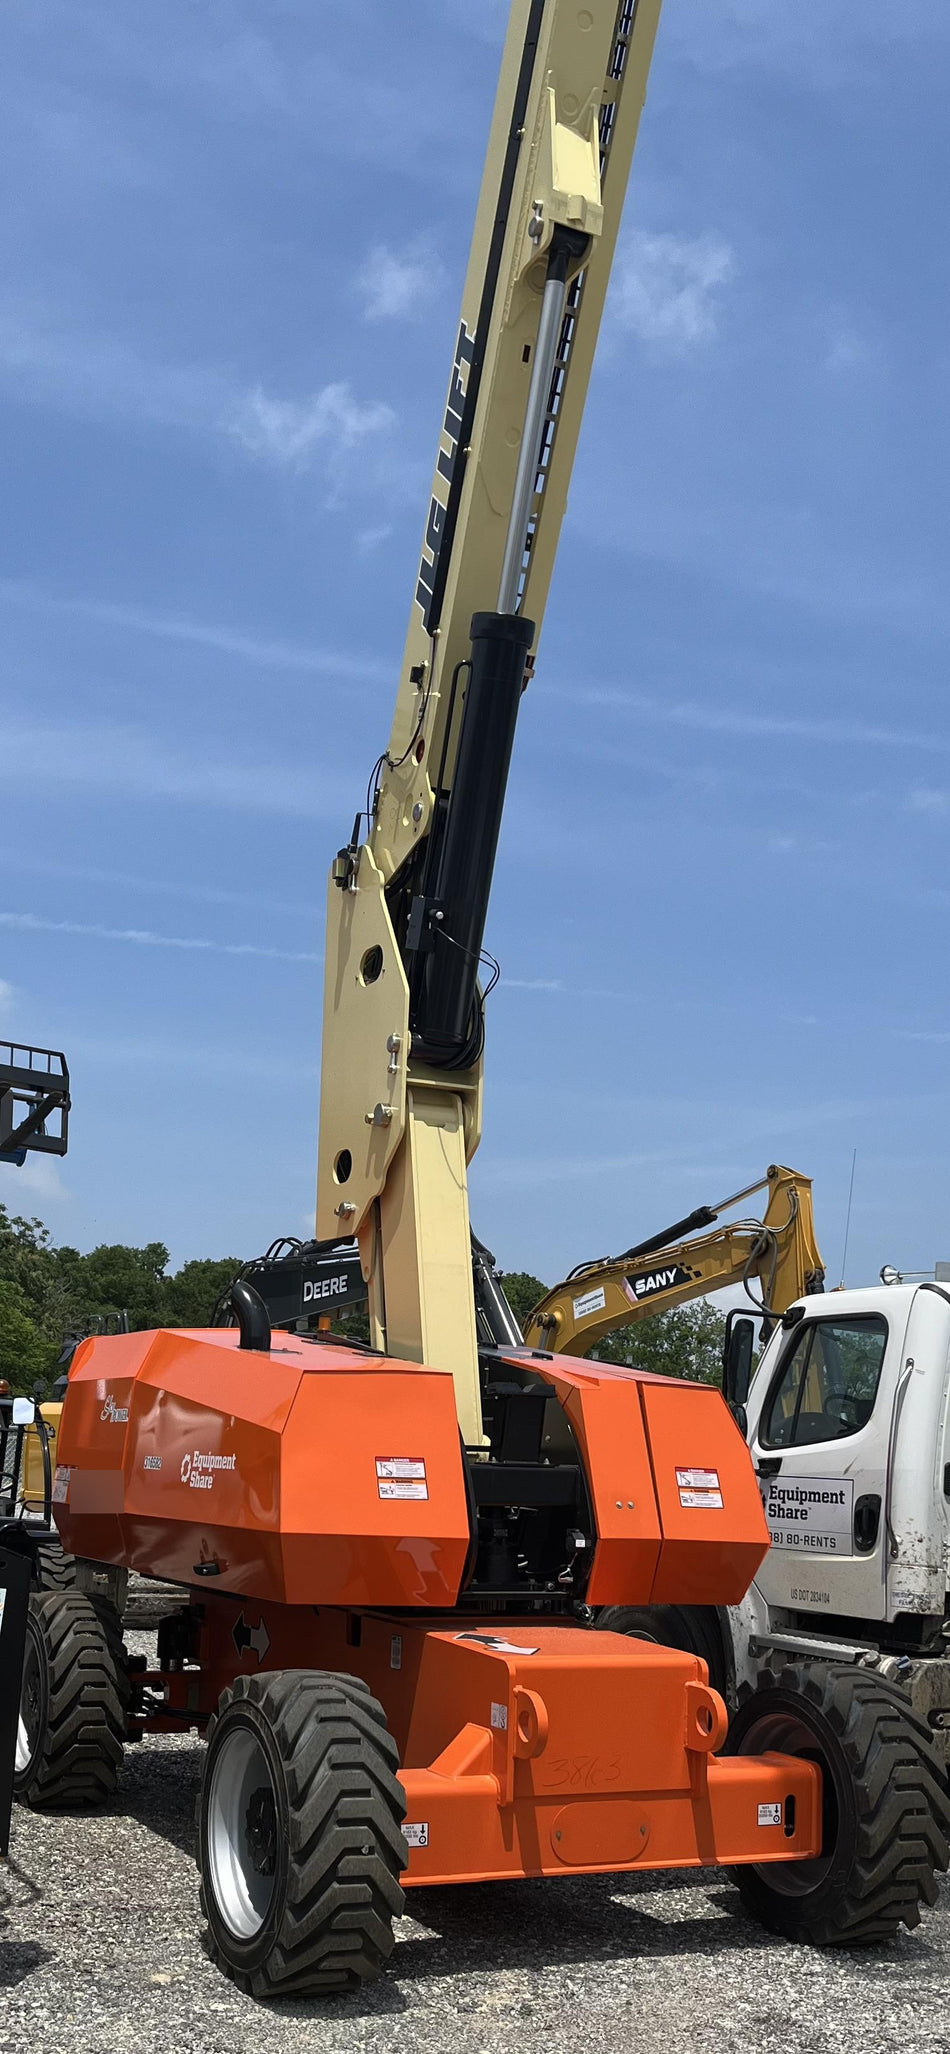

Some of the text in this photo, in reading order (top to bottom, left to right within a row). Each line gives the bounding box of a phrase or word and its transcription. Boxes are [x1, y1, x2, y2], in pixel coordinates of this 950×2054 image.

[303, 1274, 348, 1302] DEERE
[635, 1267, 678, 1295] SANY
[192, 1450, 236, 1472] Equipment
[189, 1470, 213, 1489] Share
[769, 1485, 846, 1505] Equipment
[768, 1503, 808, 1520] Share
[786, 1533, 837, 1548] 80-RENTS
[790, 1588, 798, 1600] US
[798, 1589, 809, 1601] DOT
